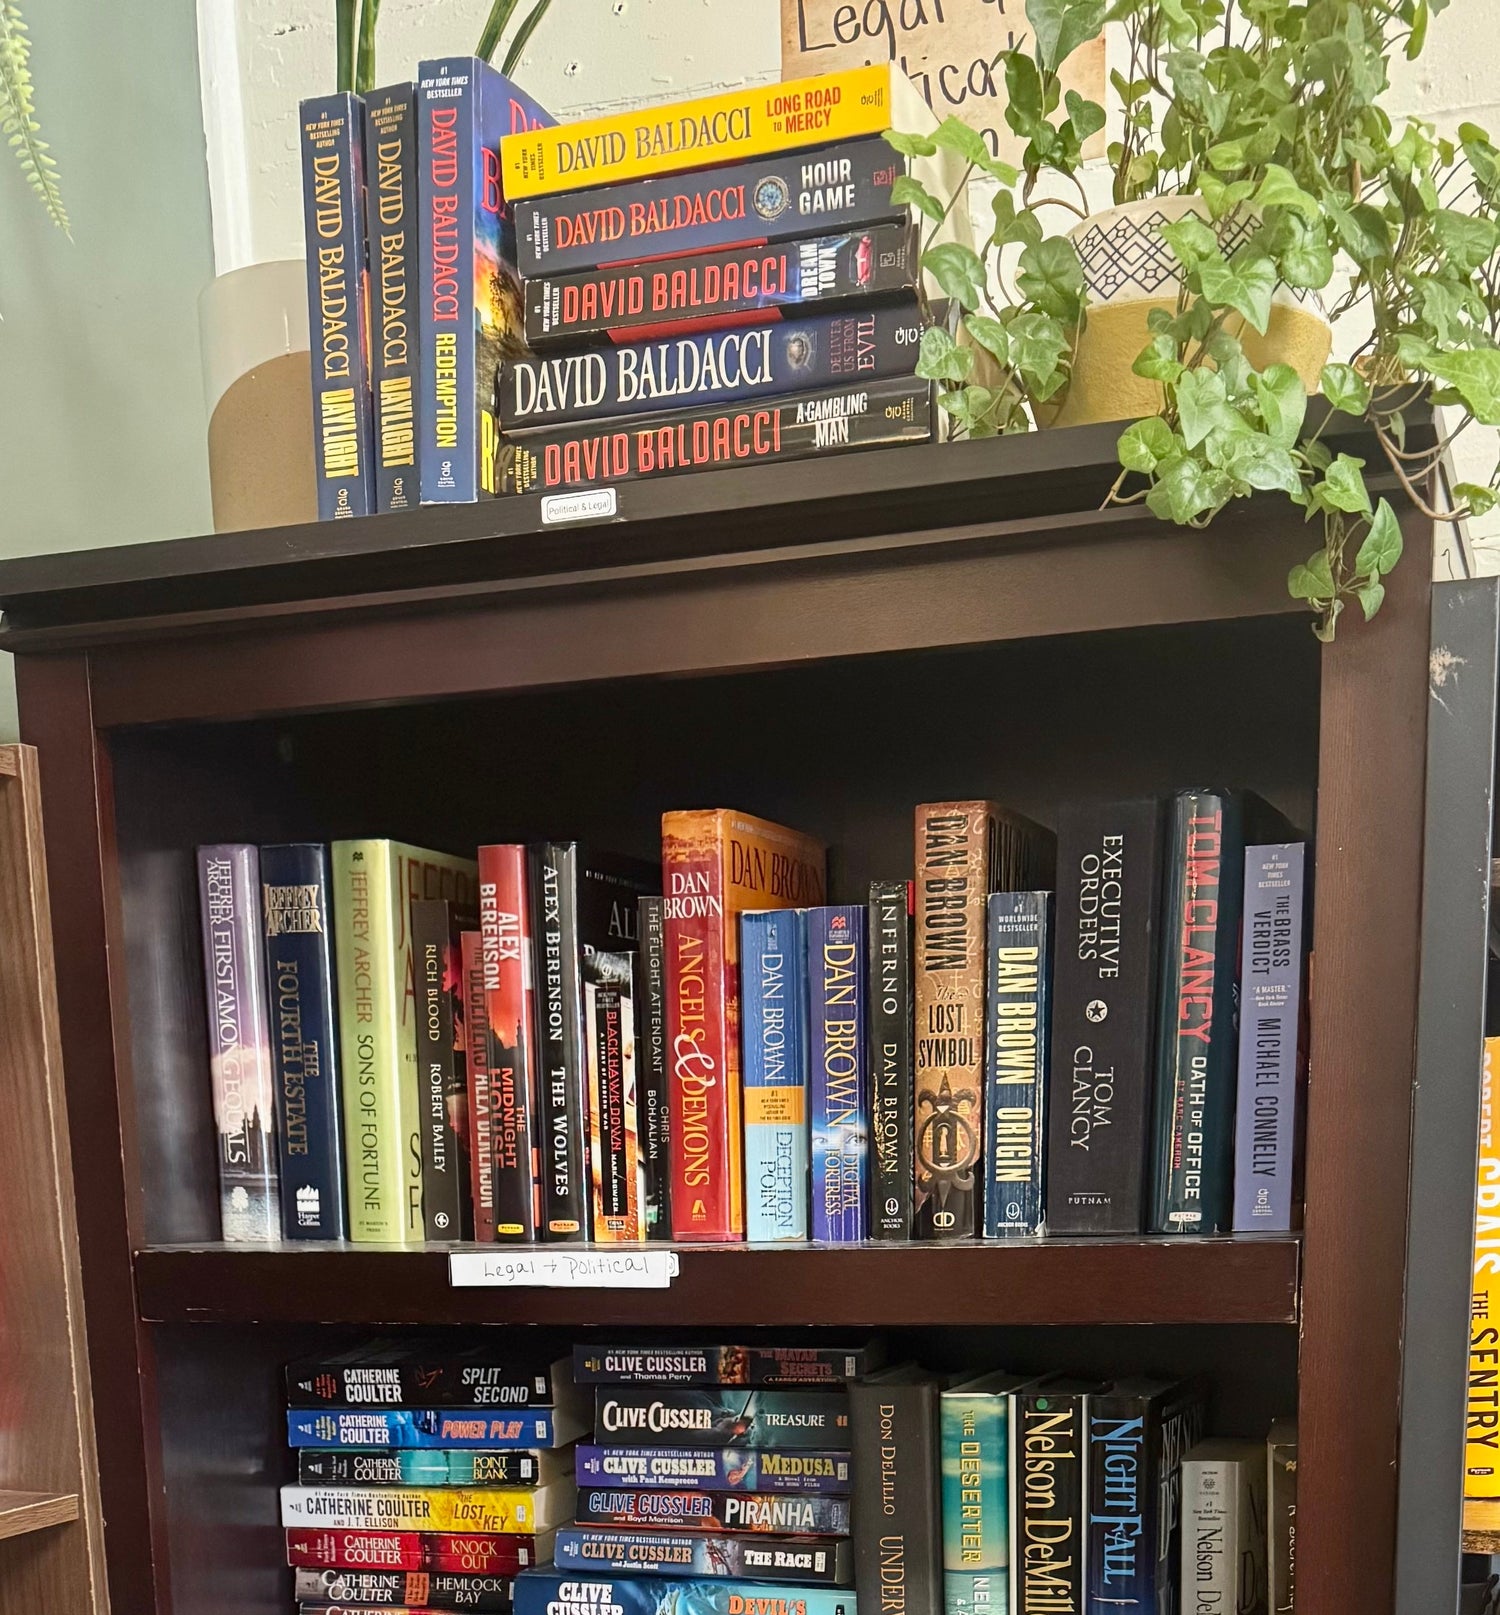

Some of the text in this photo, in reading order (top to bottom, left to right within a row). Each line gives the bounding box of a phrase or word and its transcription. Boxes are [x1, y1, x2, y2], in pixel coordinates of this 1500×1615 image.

[427, 88, 462, 99] BESTSELLER
[766, 86, 841, 118] LONG ROAD
[557, 131, 625, 174] DAVID
[635, 107, 752, 159] BALDACCI
[773, 109, 832, 133] TO MERCY
[314, 153, 343, 238] DAVID
[802, 159, 851, 188] HOUR
[799, 184, 856, 216] GAME
[432, 108, 458, 448] DAVID BALDACCI REDEMPTION
[801, 243, 818, 297] DREAM
[818, 247, 837, 290] TOWN
[319, 245, 350, 380] BALDACCI
[857, 314, 875, 370] EVIL
[514, 330, 773, 415] DAVID BALDACCI
[806, 393, 868, 419] GAMBLING
[321, 388, 359, 478] DAYLIGHT
[816, 418, 849, 448] MAN
[548, 499, 610, 516] Political & Legal
[207, 860, 222, 925] ARCHER
[215, 857, 235, 924] JEFFREY
[663, 893, 722, 919] BROWN
[671, 871, 709, 895] DAN
[1079, 853, 1100, 960] ORDERS
[1099, 835, 1124, 979] EXECUTIVE
[998, 923, 1038, 932] BESTSELLER
[999, 915, 1038, 924] WORLDWIDE
[1253, 911, 1270, 975] VERDICT
[1273, 919, 1290, 967] BRASS
[881, 894, 897, 1015] INFERNO
[349, 871, 381, 1210] JEFFREY ARCHER SONS OF FORTUNE
[543, 865, 569, 1196] ALEX BERENSON THE WOLVES
[651, 990, 662, 1073] ATTENDANT
[928, 1004, 963, 1033] LOST
[425, 944, 446, 1172] RICH BLOOD ROBERT BAILEY
[918, 1038, 975, 1068] SYMBOL
[502, 1068, 516, 1167] MIDNIGHT
[1071, 1046, 1093, 1151] CLANCY
[1093, 1068, 1113, 1127] TOM
[1253, 1019, 1281, 1177] MICHAEL CONNELLY
[648, 1090, 658, 1159] BOHJALIAN
[682, 1077, 710, 1186] DEMONS
[995, 1107, 1033, 1183] ORIGIN
[1068, 1196, 1111, 1204] PUTNAM
[484, 1261, 535, 1281] Legal
[563, 1256, 649, 1280] Political
[344, 1369, 399, 1383] CATHERINE
[345, 1384, 402, 1402] COULTER
[462, 1368, 501, 1385] SPLIT
[473, 1386, 528, 1403] SECOND
[1467, 1328, 1500, 1449] SENTRY
[766, 1413, 824, 1427] TREASURE
[762, 1454, 834, 1476] MEDUSA
[1024, 1409, 1076, 1510] Nelson
[306, 1498, 430, 1517] CATHERINE COULTER
[454, 1503, 484, 1519] LOST
[483, 1514, 508, 1530] KEY
[726, 1499, 814, 1527] PIRANHA
[960, 1442, 982, 1564] DESERTER
